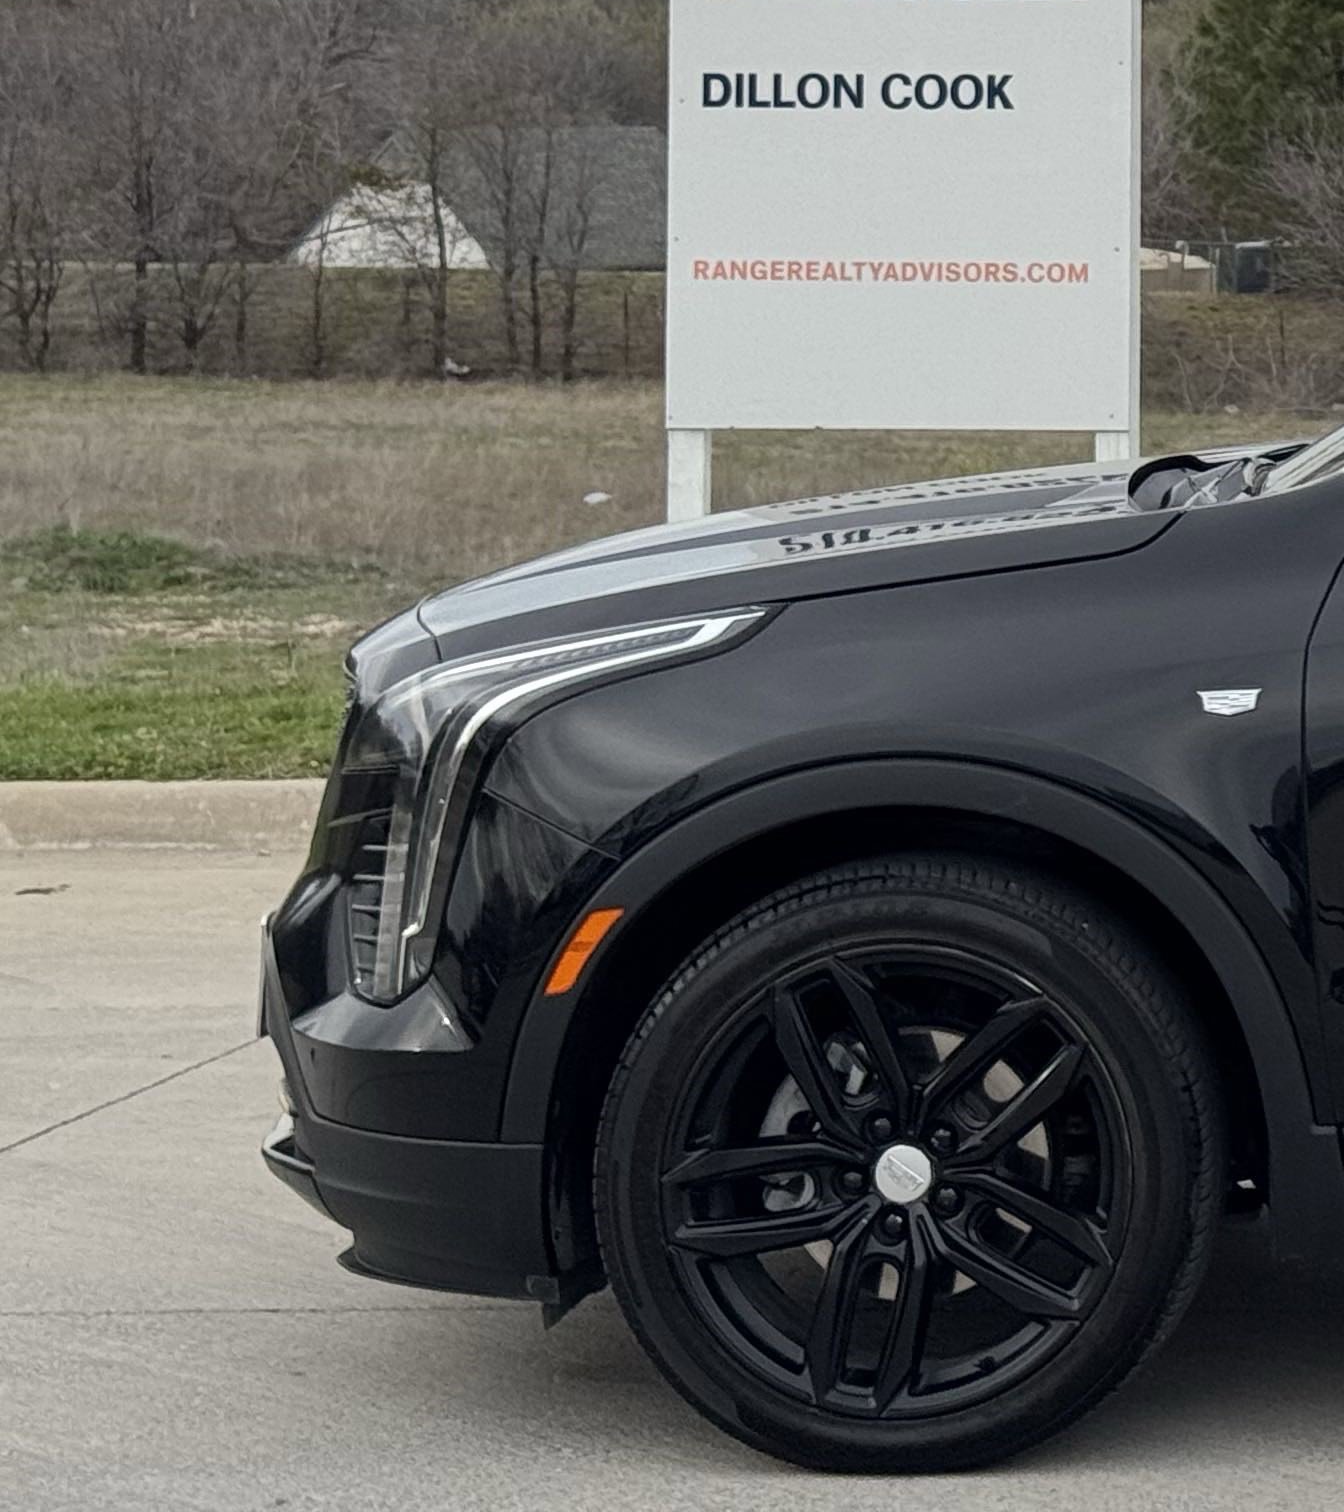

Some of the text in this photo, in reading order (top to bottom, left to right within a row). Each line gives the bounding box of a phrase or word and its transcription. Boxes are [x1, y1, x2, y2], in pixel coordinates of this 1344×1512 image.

[702, 73, 1014, 110] DILLON COOK
[693, 260, 1089, 283] RANGEREALTYADVISORS.COM
